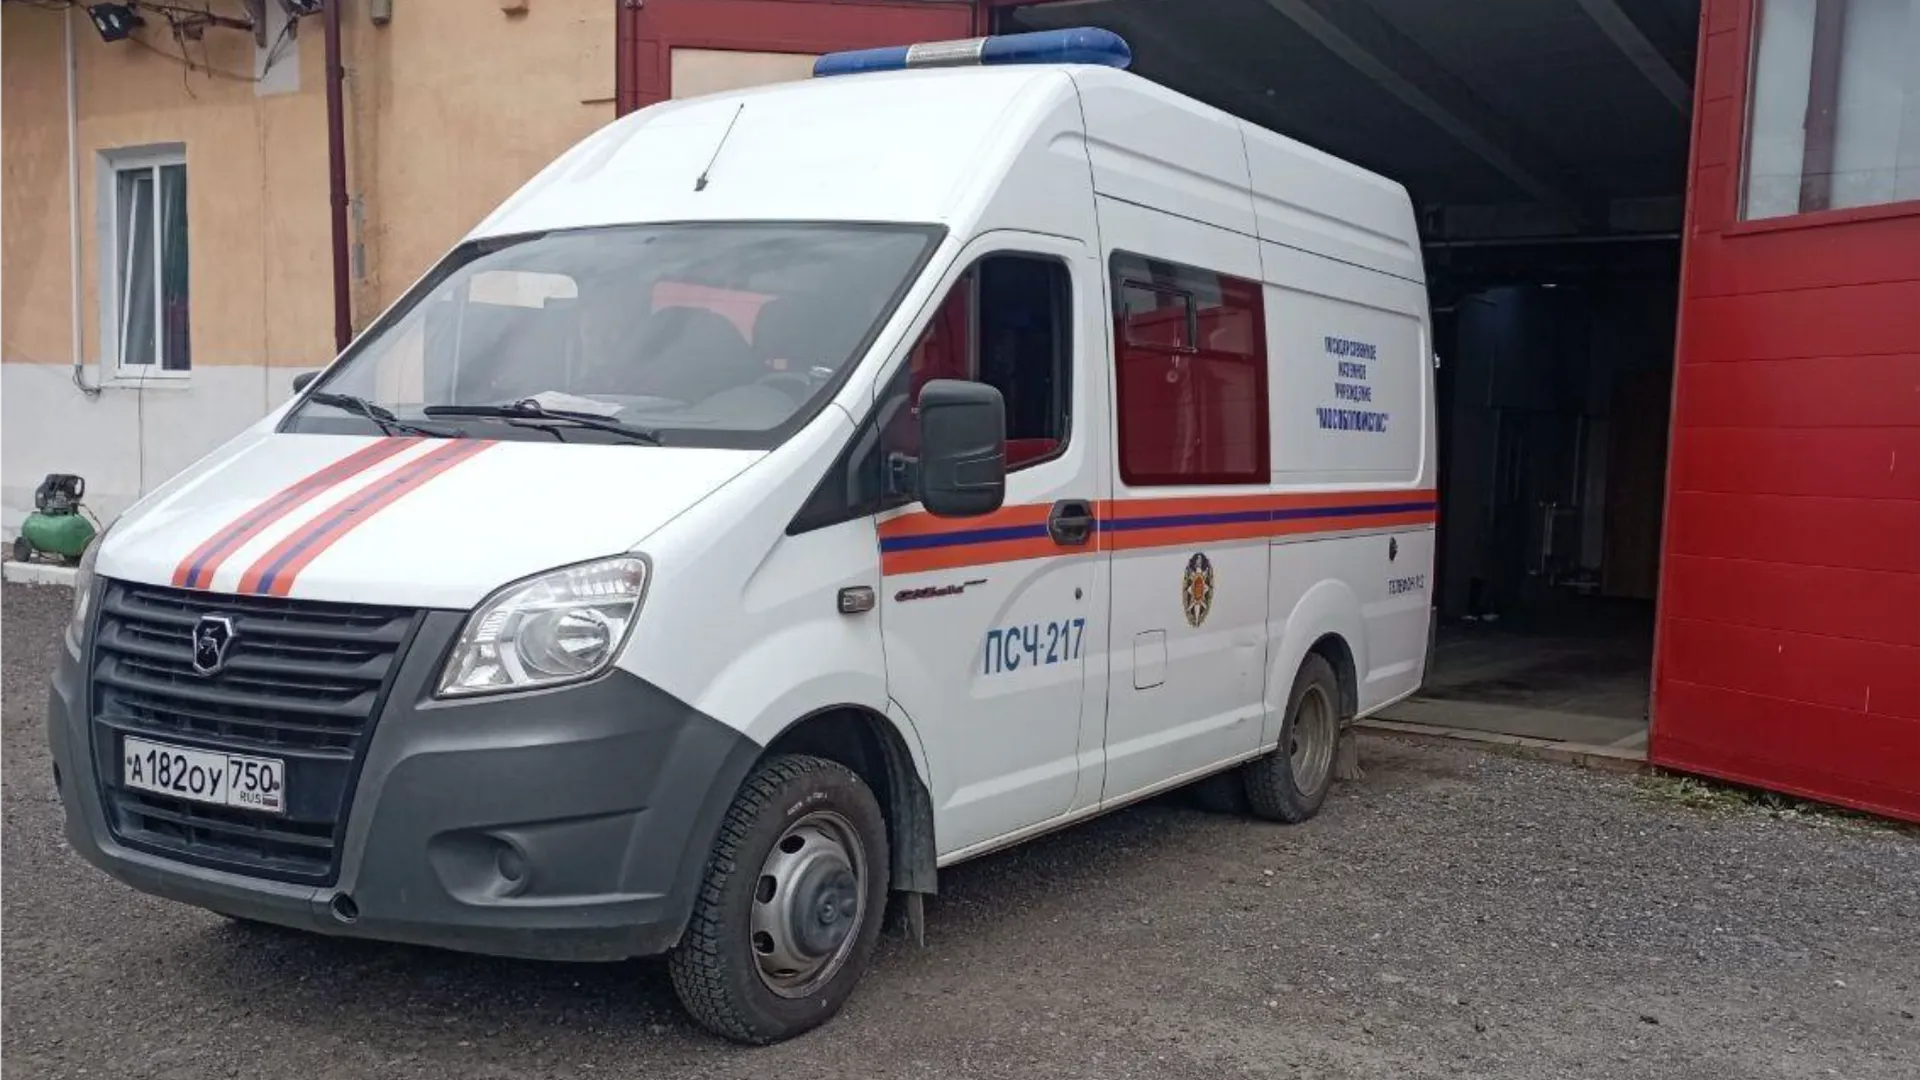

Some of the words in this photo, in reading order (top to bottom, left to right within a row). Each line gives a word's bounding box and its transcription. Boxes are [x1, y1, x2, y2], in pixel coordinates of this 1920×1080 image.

[984, 618, 1085, 675] ПСЧ-217
[230, 760, 274, 793] 750
[239, 790, 262, 804] RUS
